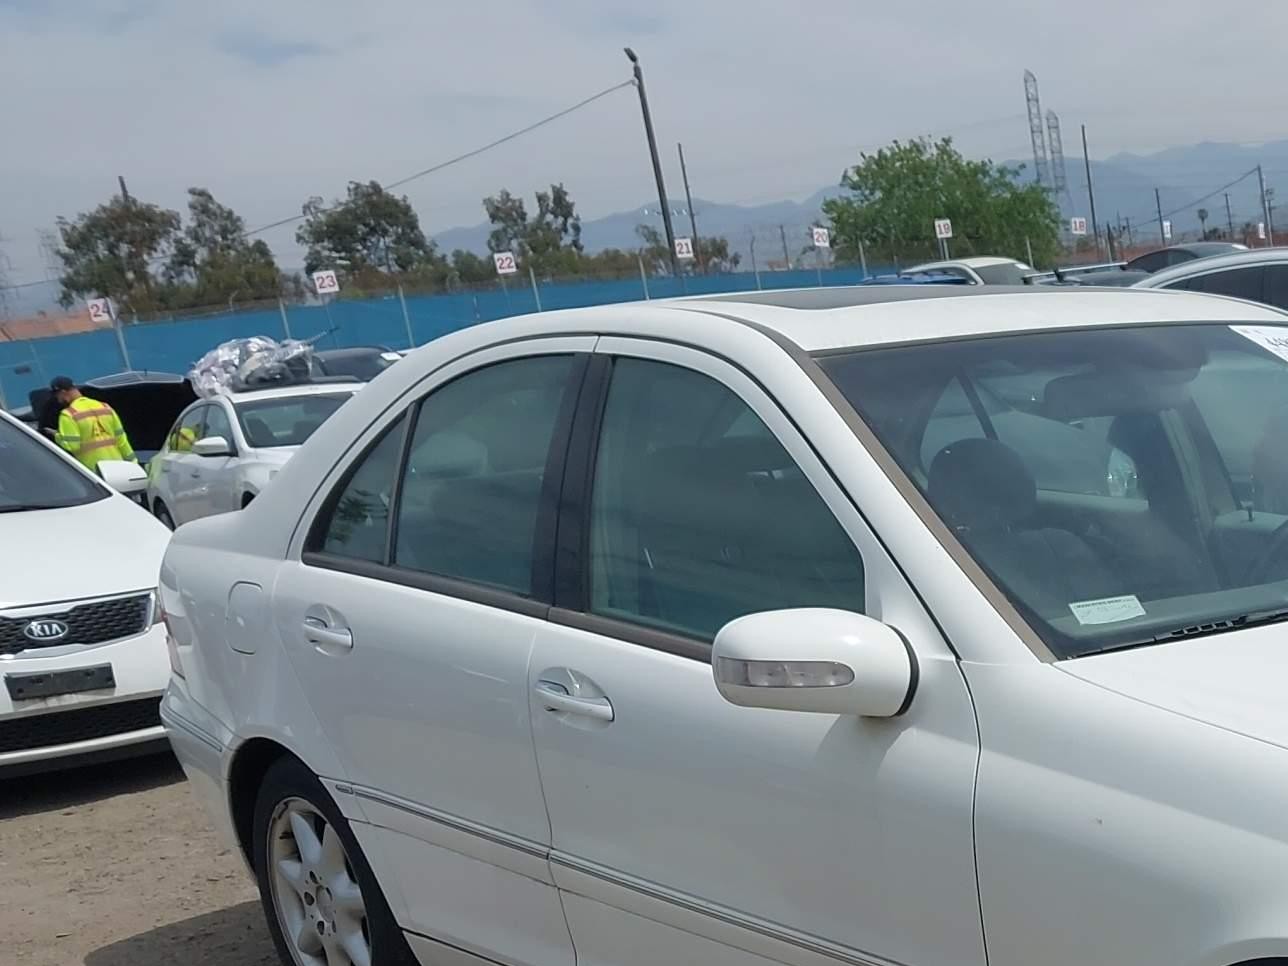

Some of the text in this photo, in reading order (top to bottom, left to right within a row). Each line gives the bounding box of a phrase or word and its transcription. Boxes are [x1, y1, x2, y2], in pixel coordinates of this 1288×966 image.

[815, 231, 828, 243] 20
[676, 242, 692, 255] 21
[496, 256, 514, 270] 22
[316, 275, 336, 289] 23
[31, 622, 62, 638] KIA
